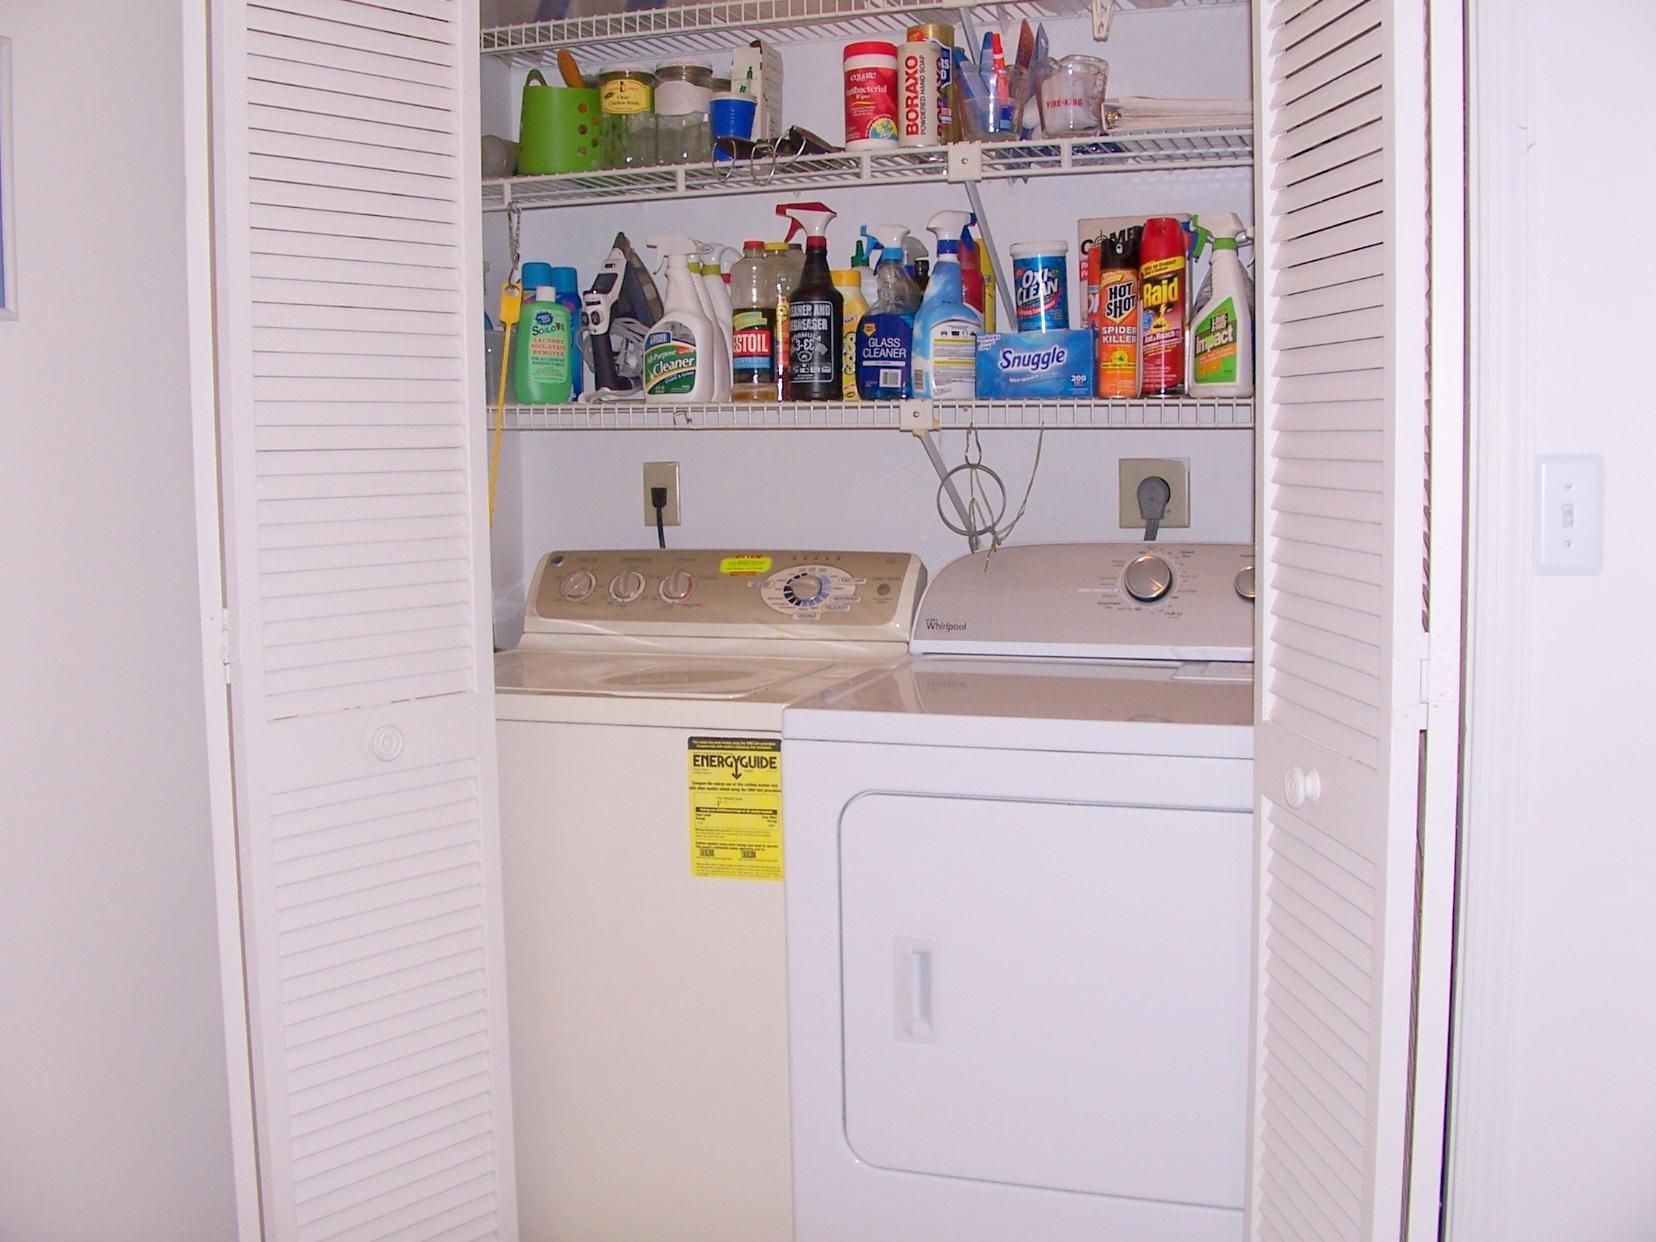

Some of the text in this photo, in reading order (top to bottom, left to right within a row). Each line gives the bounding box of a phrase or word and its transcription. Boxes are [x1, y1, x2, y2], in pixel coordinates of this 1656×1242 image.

[905, 55, 919, 135] BORAXO
[1022, 268, 1049, 288] OXI
[1016, 279, 1059, 306] CLEAN
[1109, 282, 1133, 300] HOT
[1143, 277, 1179, 308] Raid
[813, 303, 831, 316] AND
[1106, 295, 1136, 318] SHOT
[868, 337, 901, 348] GLASS
[863, 347, 907, 359] CLEANER
[1000, 346, 1066, 371] Snuggle
[653, 357, 695, 376] Cleaner
[926, 620, 967, 632] Whirlpool
[693, 754, 777, 770] ENERGYGUIDE
